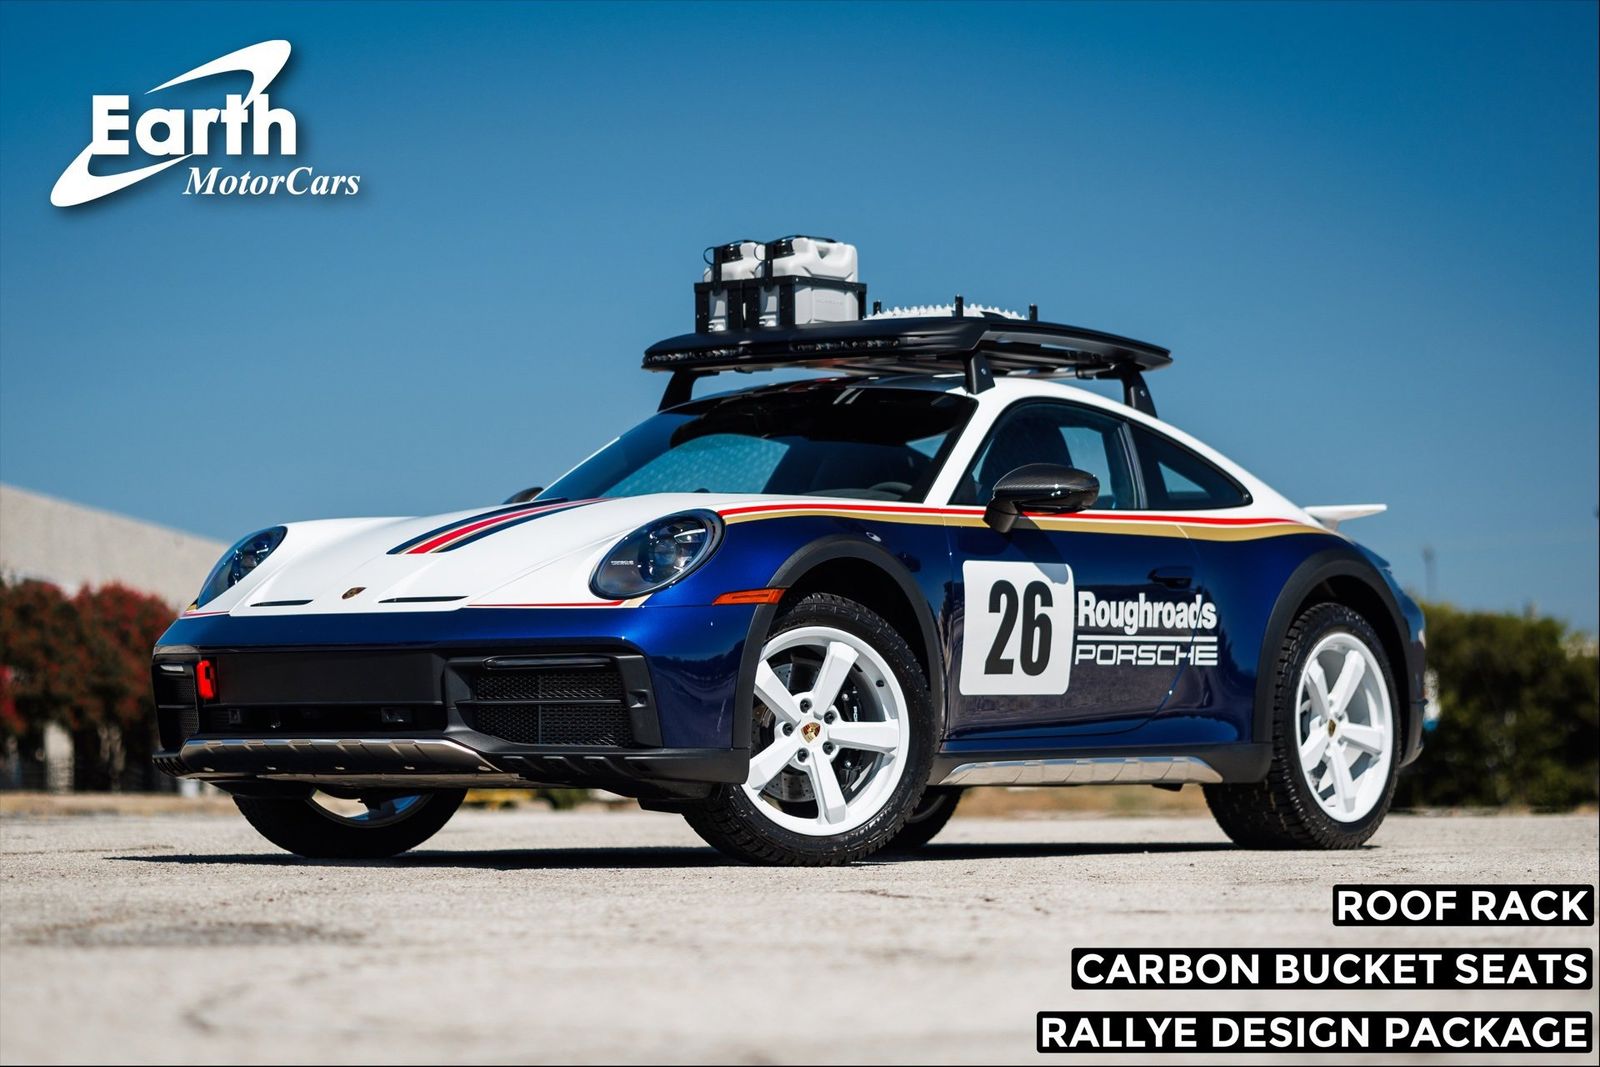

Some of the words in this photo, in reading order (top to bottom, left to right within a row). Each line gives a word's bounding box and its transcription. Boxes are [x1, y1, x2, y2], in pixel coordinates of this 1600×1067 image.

[984, 578, 1054, 677] 26
[1077, 591, 1218, 635] Roughroads
[1075, 644, 1219, 666] PORSCHE
